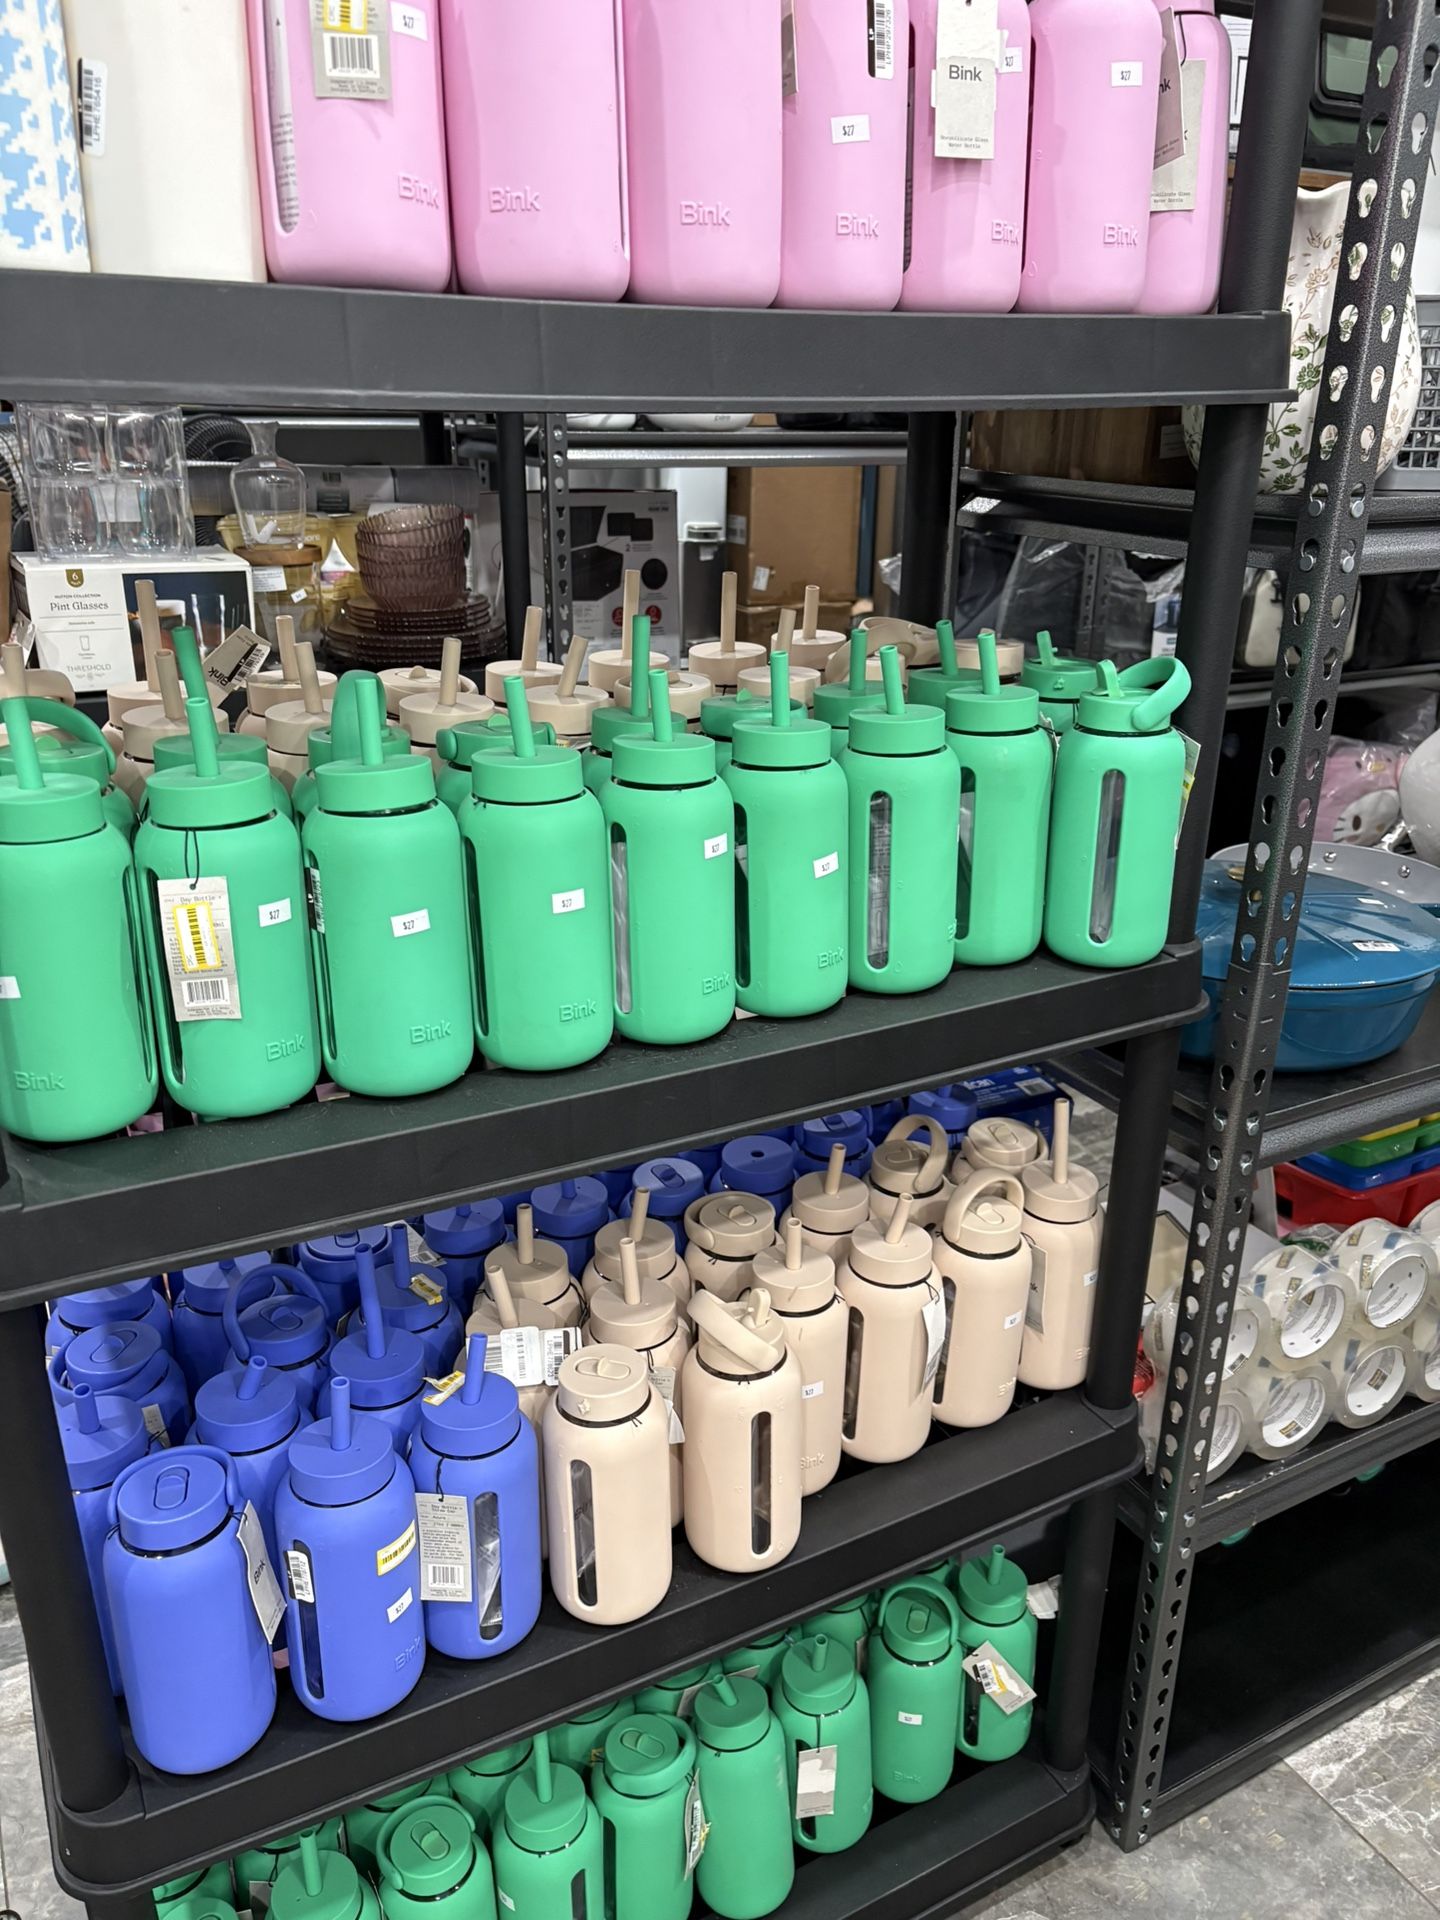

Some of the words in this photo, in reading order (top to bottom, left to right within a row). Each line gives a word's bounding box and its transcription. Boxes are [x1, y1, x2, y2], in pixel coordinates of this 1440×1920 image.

[948, 64, 983, 82] Bink
[1120, 69, 1132, 82] $27
[1158, 77, 1172, 94] nk
[842, 123, 855, 137] $27
[398, 174, 439, 209] Bink
[488, 186, 541, 213] Bink
[679, 200, 730, 227] Bink
[835, 212, 879, 239] Bink
[991, 219, 1019, 245] Bink
[1102, 222, 1138, 248] Bink
[71, 571, 79, 581] 6
[50, 601, 71, 612] Pint
[72, 600, 110, 611] Glasses
[67, 662, 112, 673] THRESHOLD
[208, 666, 232, 687] Bink
[269, 908, 281, 921] $27
[402, 919, 416, 931] $27
[816, 946, 845, 970] Bink
[702, 971, 731, 996] Bink
[559, 999, 597, 1023] Bink
[409, 1019, 452, 1045] Bink
[265, 1034, 306, 1062] Bink
[14, 1070, 65, 1091] Bink
[394, 1636, 421, 1673] Bink
